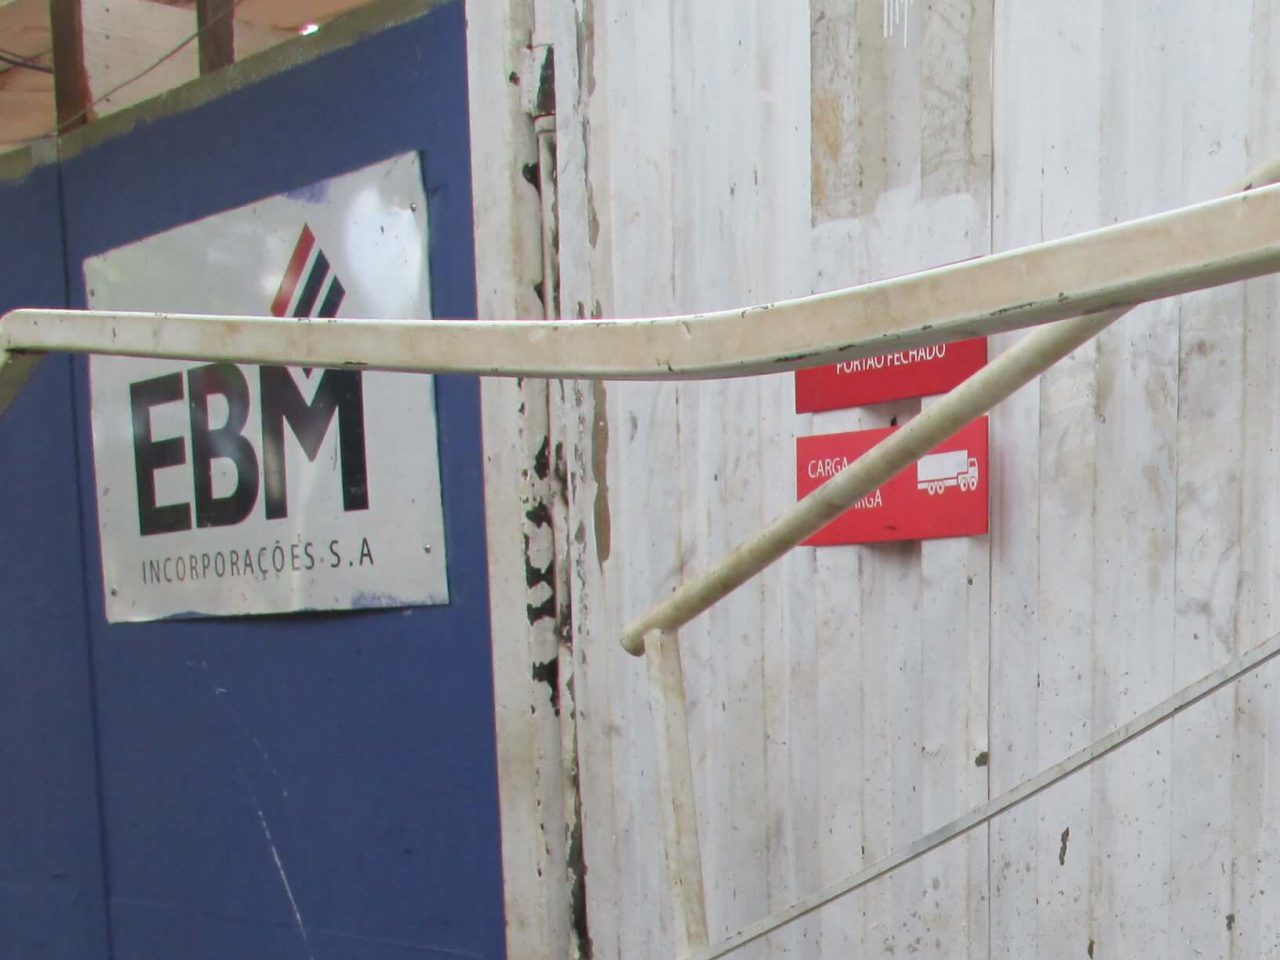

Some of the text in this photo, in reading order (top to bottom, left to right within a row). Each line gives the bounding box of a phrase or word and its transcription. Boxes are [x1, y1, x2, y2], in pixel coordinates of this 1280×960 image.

[886, 343, 946, 367] FECHADO
[129, 360, 369, 537] EBM
[807, 457, 848, 479] CARGA
